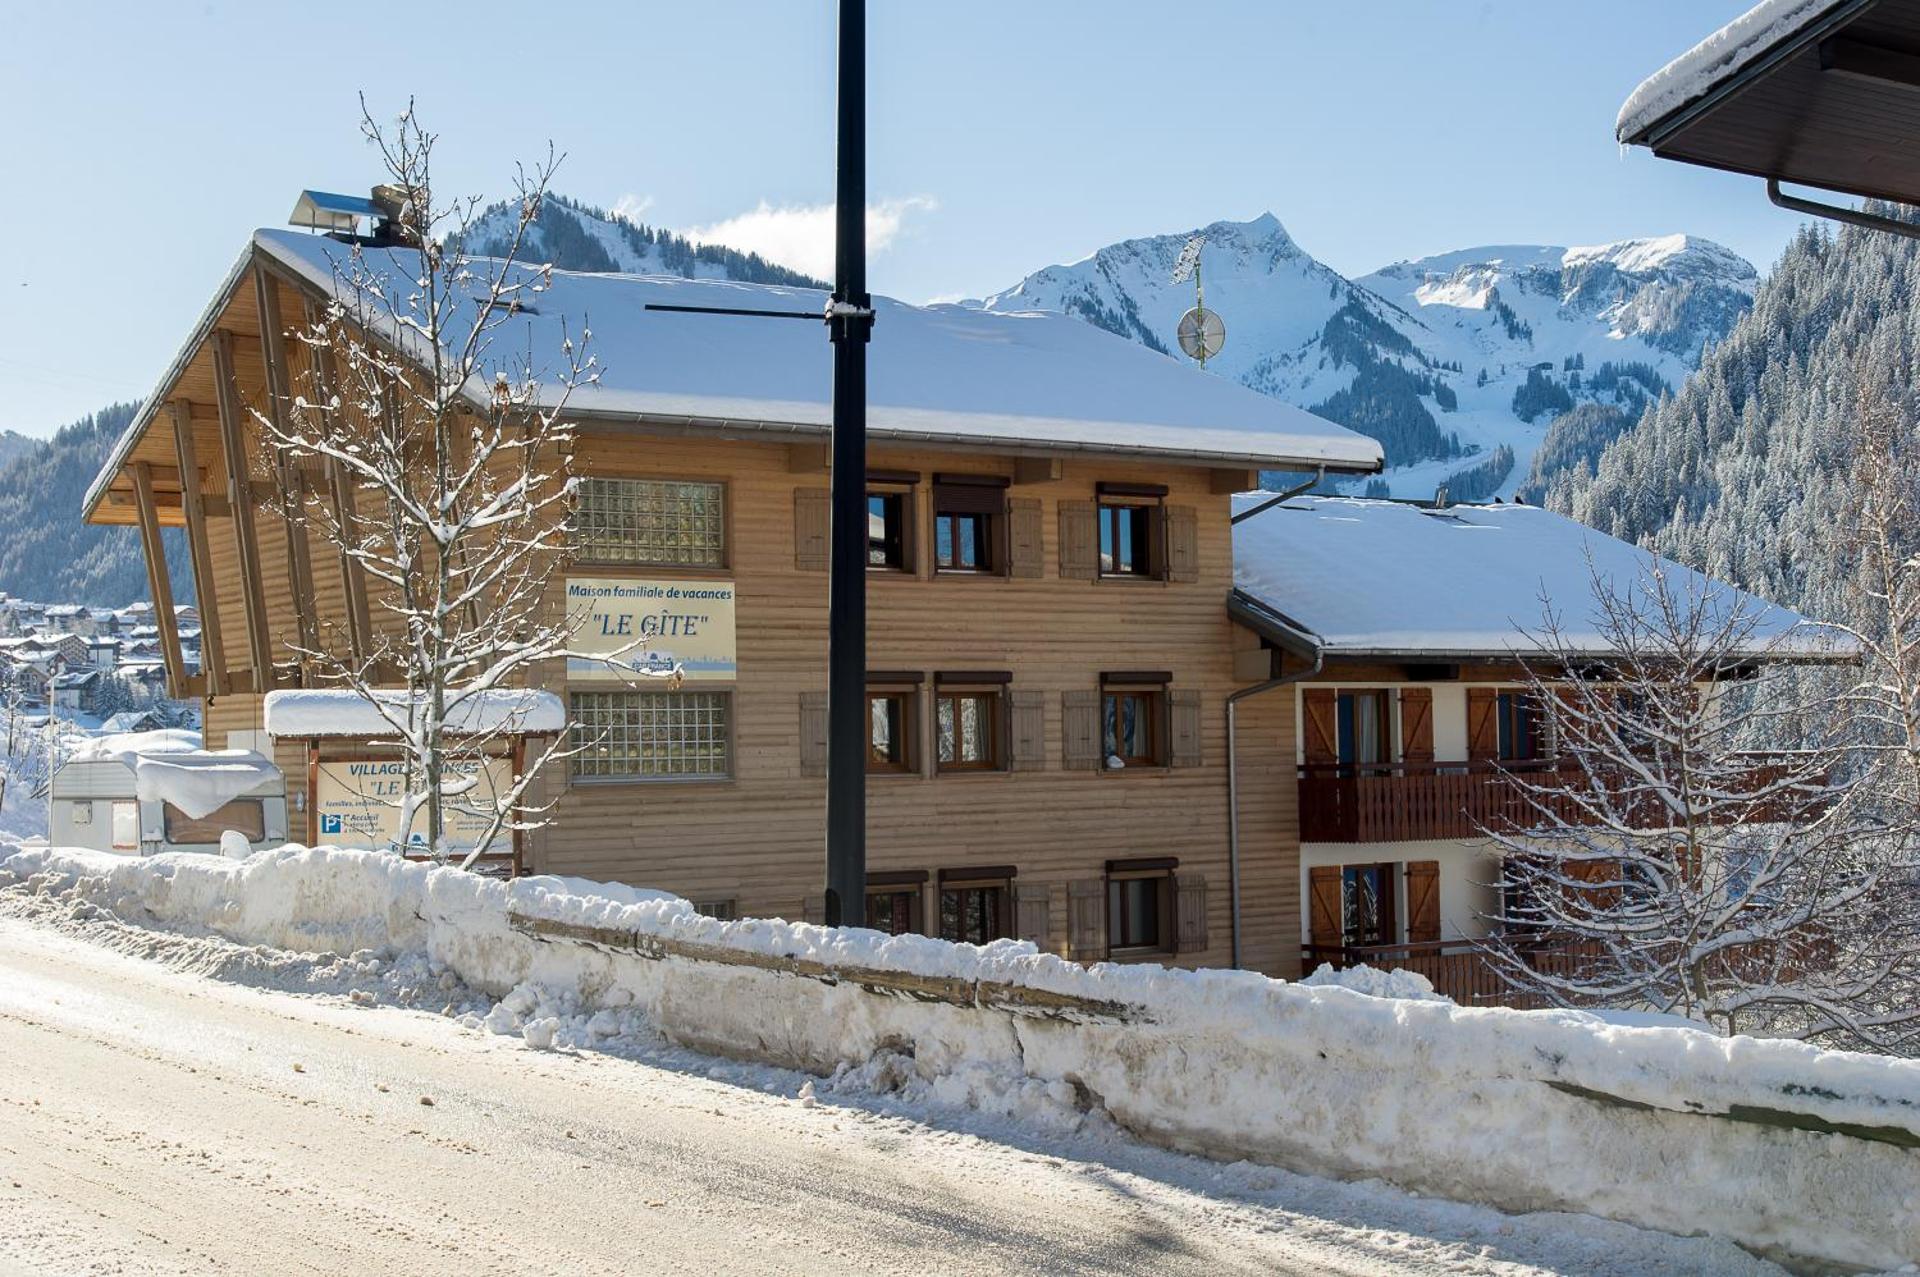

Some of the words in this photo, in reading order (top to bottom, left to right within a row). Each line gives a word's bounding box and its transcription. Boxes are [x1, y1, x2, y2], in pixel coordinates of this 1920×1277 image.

[568, 584, 612, 597] Maison
[613, 586, 664, 599] familiale
[666, 586, 681, 599] de
[682, 590, 732, 600] vacances
[593, 613, 633, 636] "LE
[640, 609, 709, 636] GÎTE"
[370, 781, 400, 796] "LE
